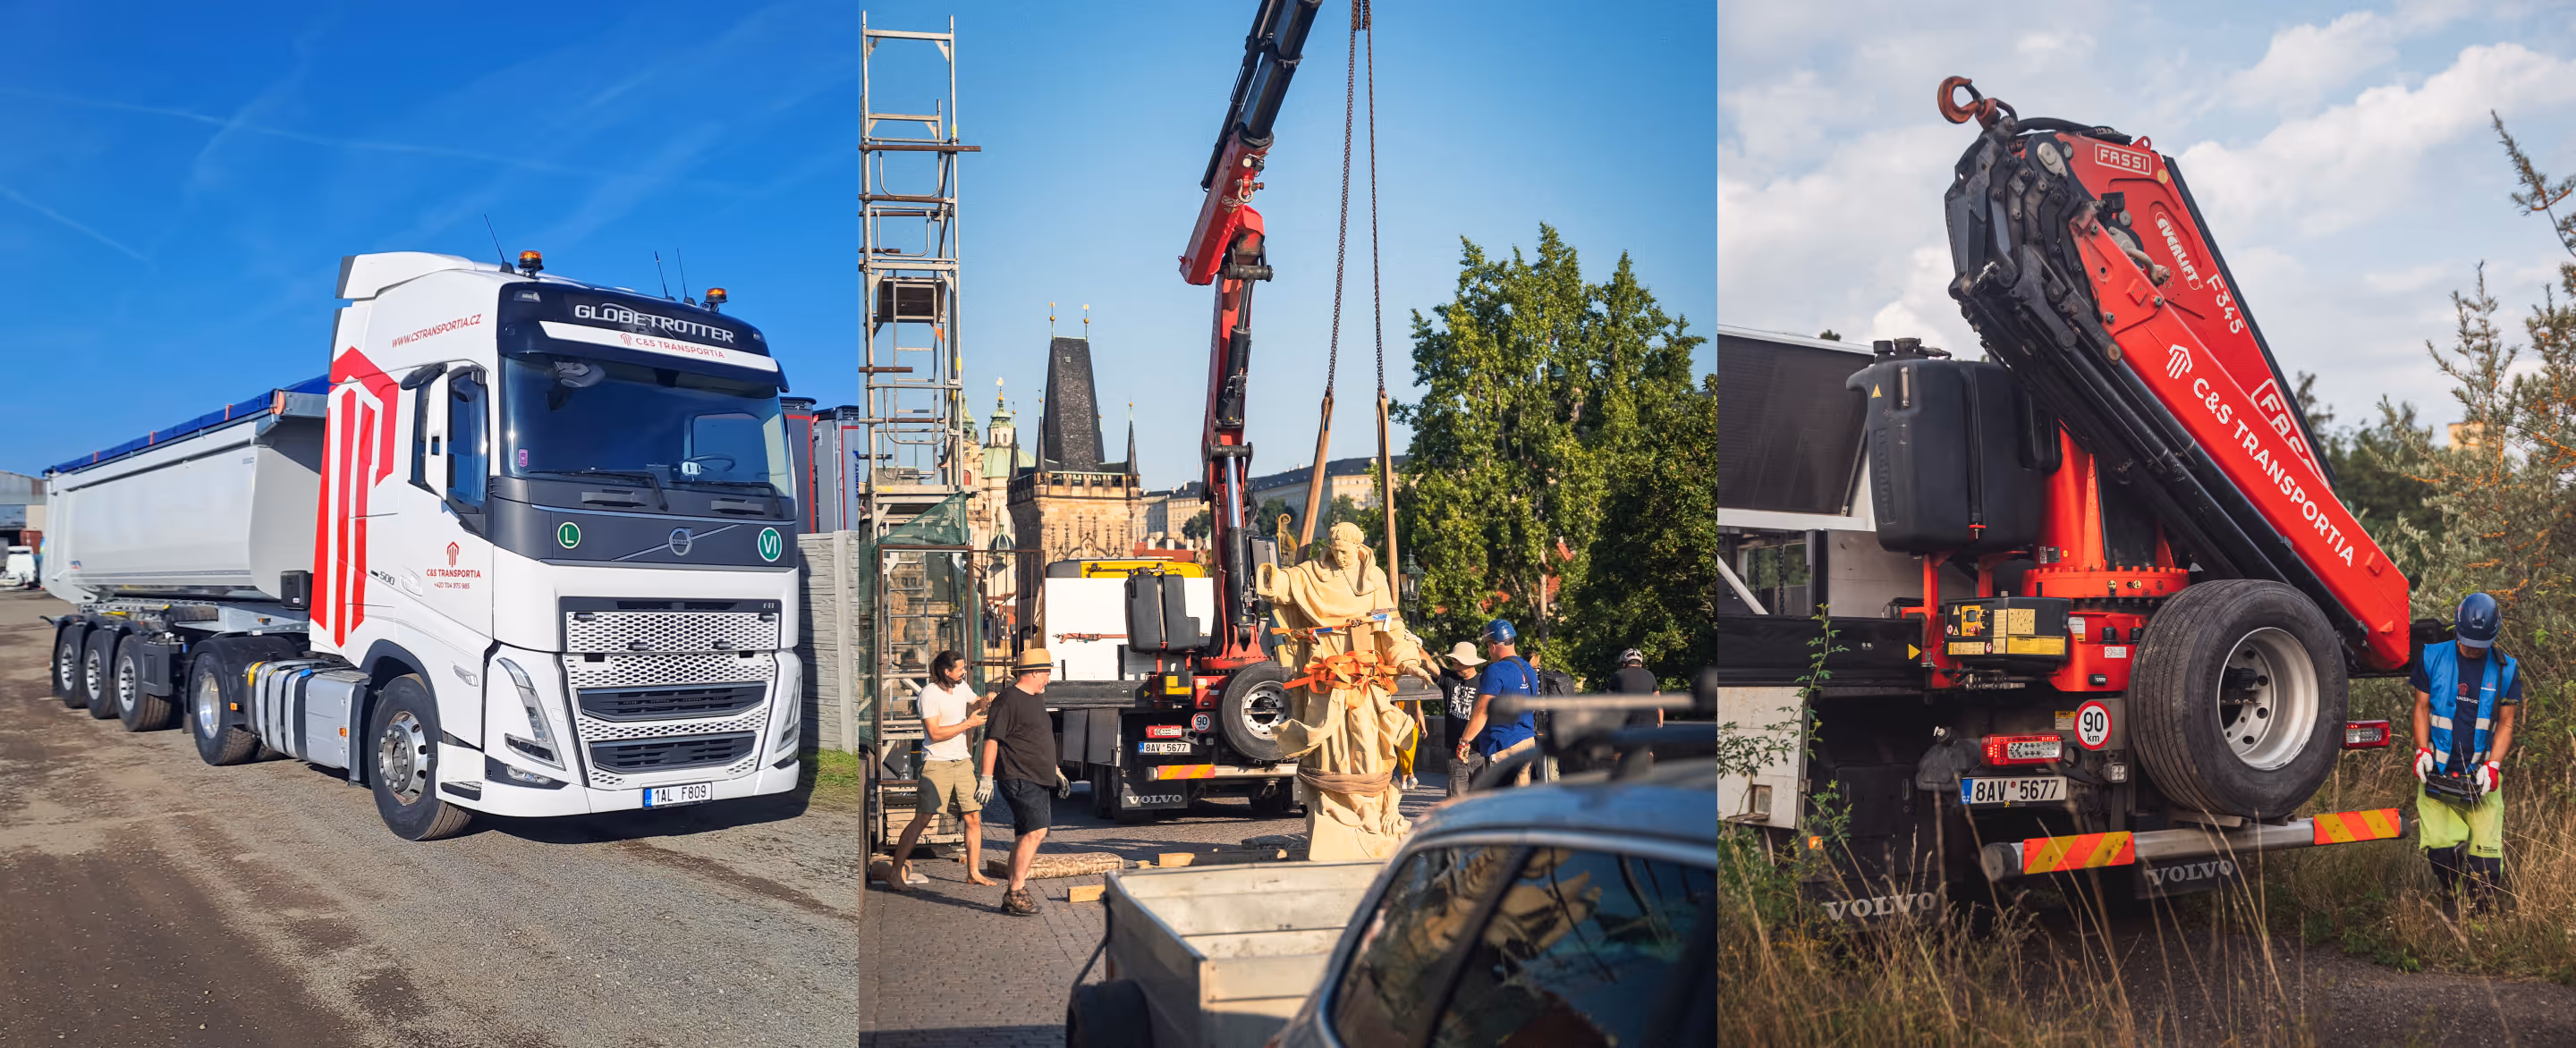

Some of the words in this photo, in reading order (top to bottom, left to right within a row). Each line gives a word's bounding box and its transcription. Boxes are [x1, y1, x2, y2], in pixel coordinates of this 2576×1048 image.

[2100, 148, 2147, 171] FASSI
[2157, 218, 2199, 283] EVERLIFT
[2207, 274, 2244, 334] F345
[392, 314, 481, 348] WWW.CSTRANSPORTIA.CZ
[574, 304, 734, 343] GLOBETROTTER
[635, 337, 656, 347] C&S
[657, 341, 725, 358] TRANSPORTIA
[2260, 393, 2315, 472] FAS
[2193, 377, 2233, 425] C&S
[2233, 418, 2354, 567] TRANSPORTIA
[564, 528, 575, 544] L
[763, 535, 777, 554] VI
[379, 571, 395, 586] 500
[426, 569, 436, 577] C&S
[438, 569, 481, 578] TRANSPORTIA
[1196, 716, 1208, 725] 90
[2083, 711, 2104, 732] 90
[1145, 743, 1161, 752] 8AV
[1166, 743, 1187, 752] 5677
[2087, 733, 2100, 742] km
[655, 788, 673, 803] 1AL
[682, 785, 706, 801] F809
[1127, 794, 1182, 805] VOLVO
[1976, 781, 2006, 801] 8AV
[2020, 780, 2059, 799] 5677
[2146, 860, 2234, 886] VOLVO
[1821, 892, 1936, 920] VOLVO
